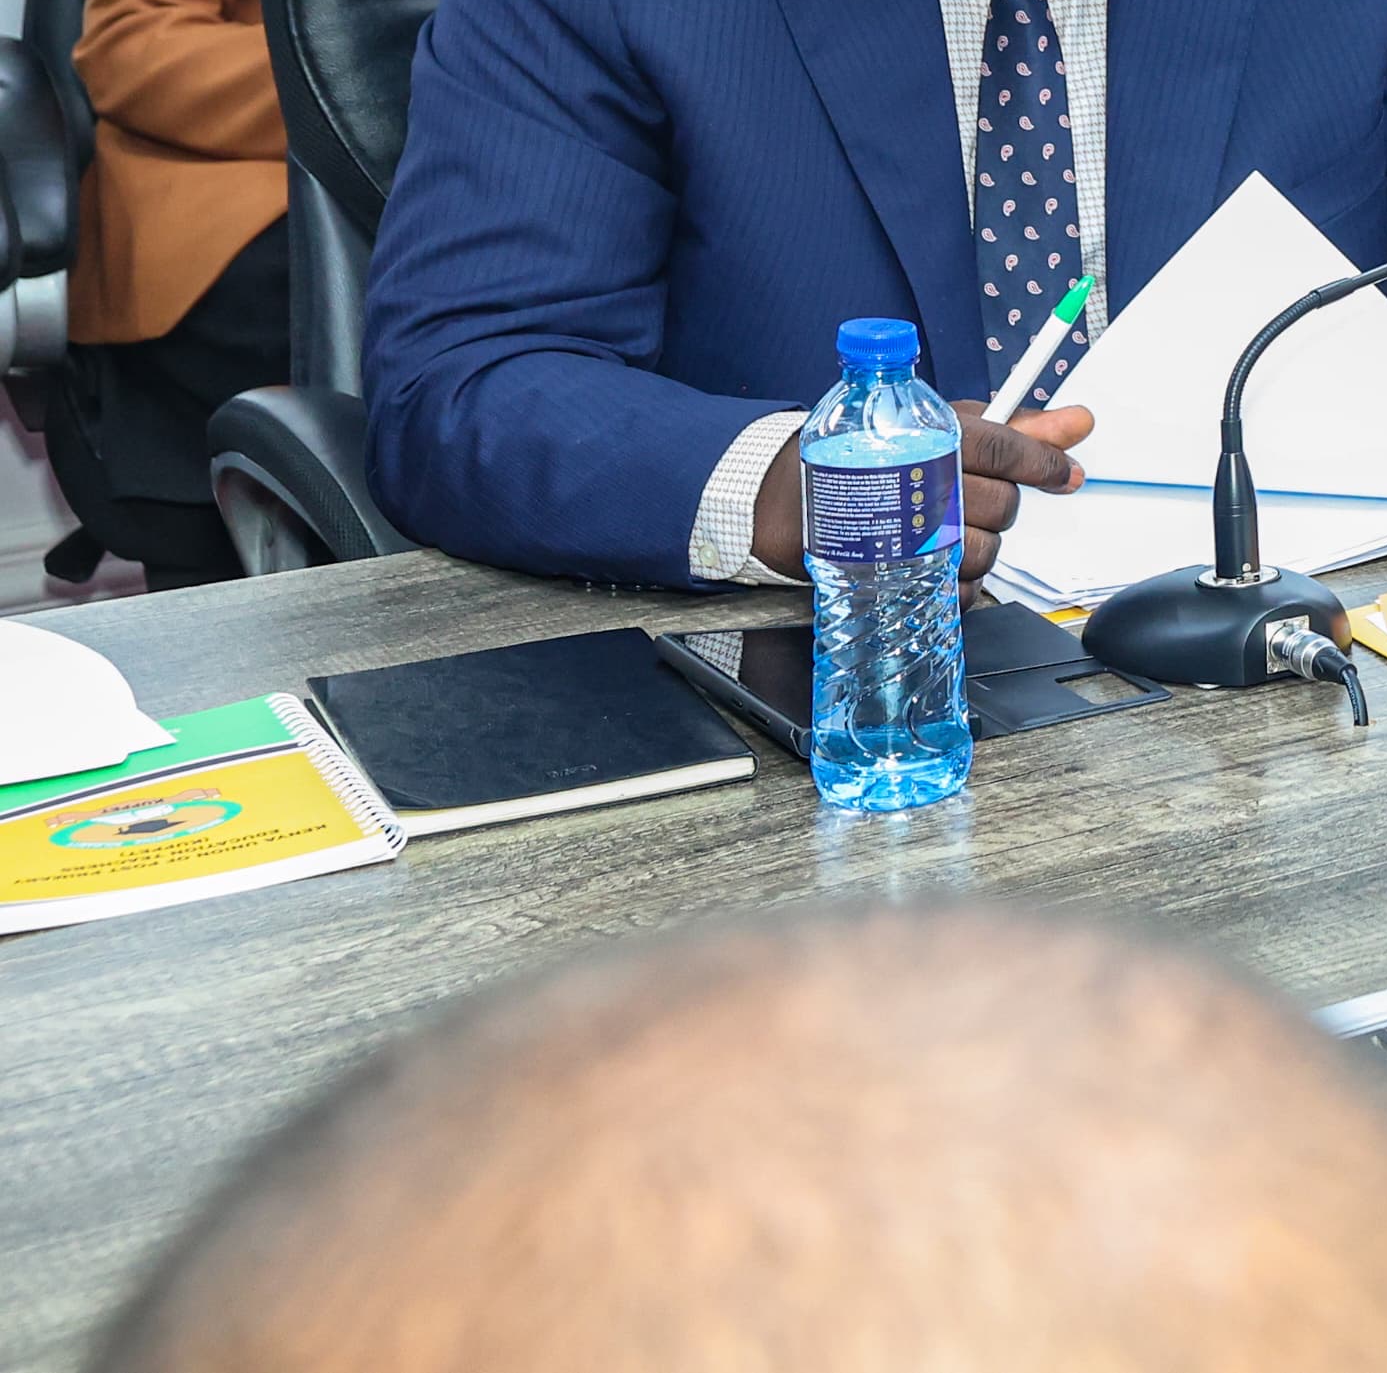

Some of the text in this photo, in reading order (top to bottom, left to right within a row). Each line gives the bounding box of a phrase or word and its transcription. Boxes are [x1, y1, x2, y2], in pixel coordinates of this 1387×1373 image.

[265, 824, 326, 842] KENYA
[120, 836, 209, 857] (KUPPET)
[170, 829, 279, 856] EDUCATION
[197, 842, 258, 857] UNION
[61, 854, 166, 872] TEACHERS
[110, 861, 158, 873] POST
[166, 856, 190, 864] OF
